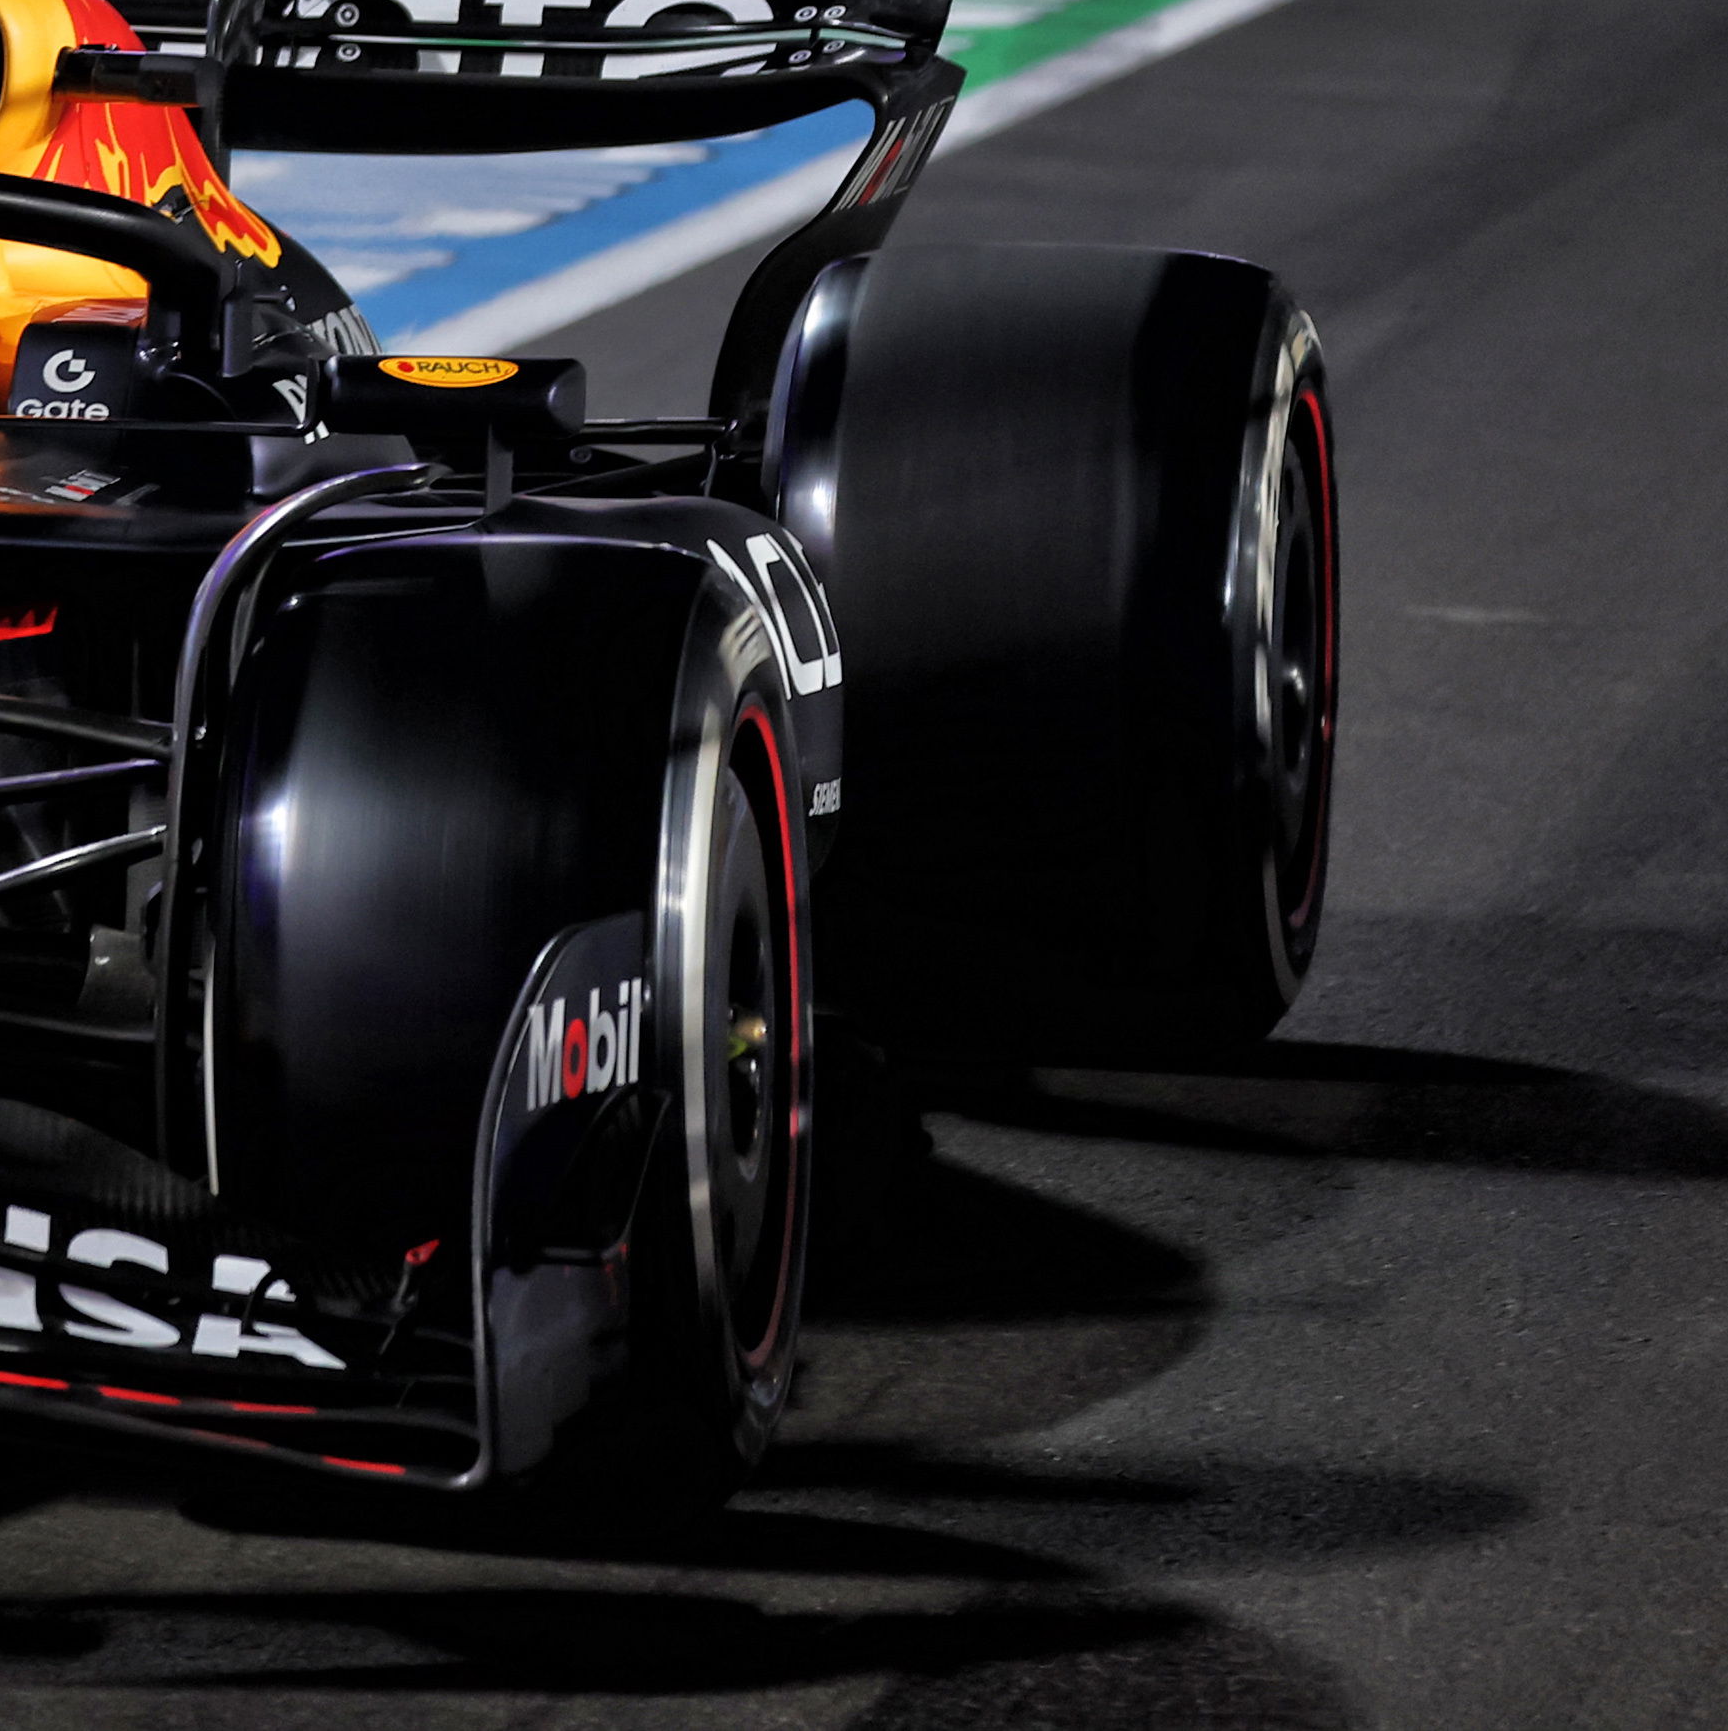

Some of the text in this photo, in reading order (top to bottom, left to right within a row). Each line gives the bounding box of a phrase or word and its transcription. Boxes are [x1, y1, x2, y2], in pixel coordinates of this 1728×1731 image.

[417, 360, 501, 375] RAUCH
[15, 398, 111, 421] Gate
[527, 976, 643, 1112] Mobil
